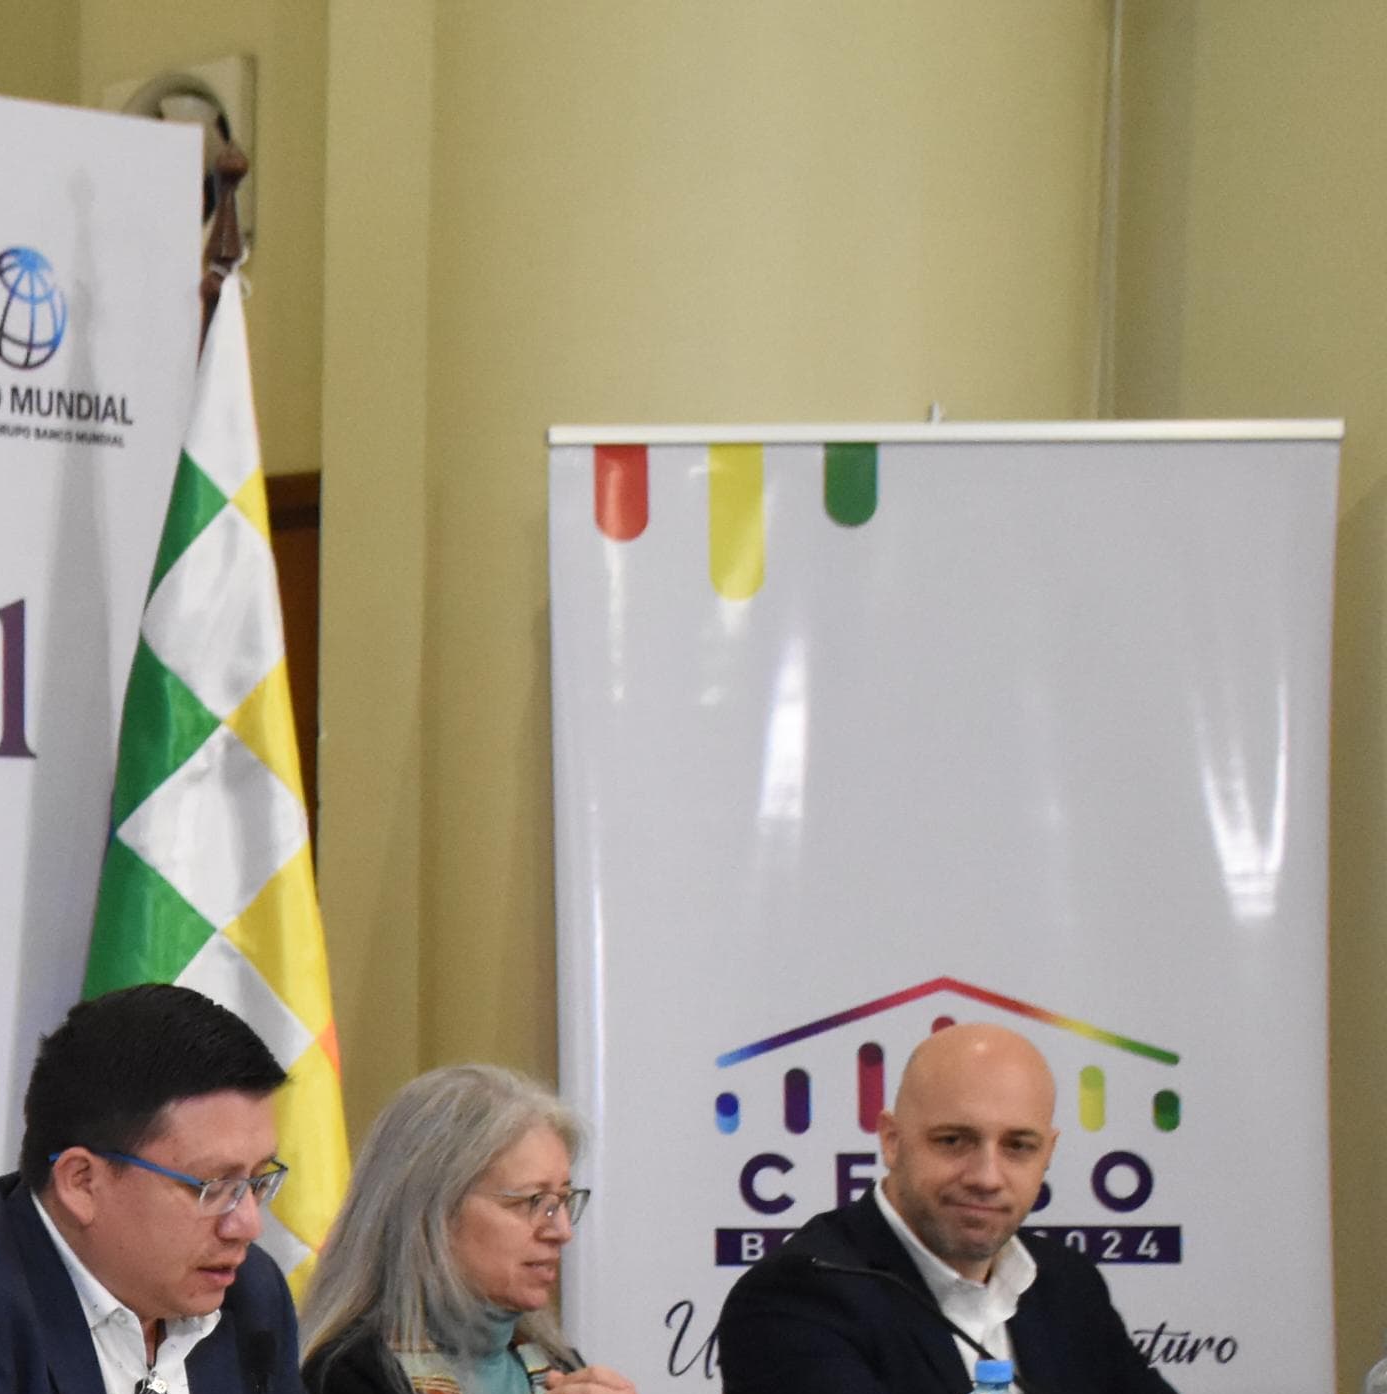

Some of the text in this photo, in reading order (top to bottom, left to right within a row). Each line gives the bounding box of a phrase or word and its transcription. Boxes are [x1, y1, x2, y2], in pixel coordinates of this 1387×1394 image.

[10, 385, 133, 425] MUNDIAL
[740, 1150, 1154, 1214] CEO
[1033, 1229, 1160, 1259] 024
[1132, 1321, 1238, 1365] turo
